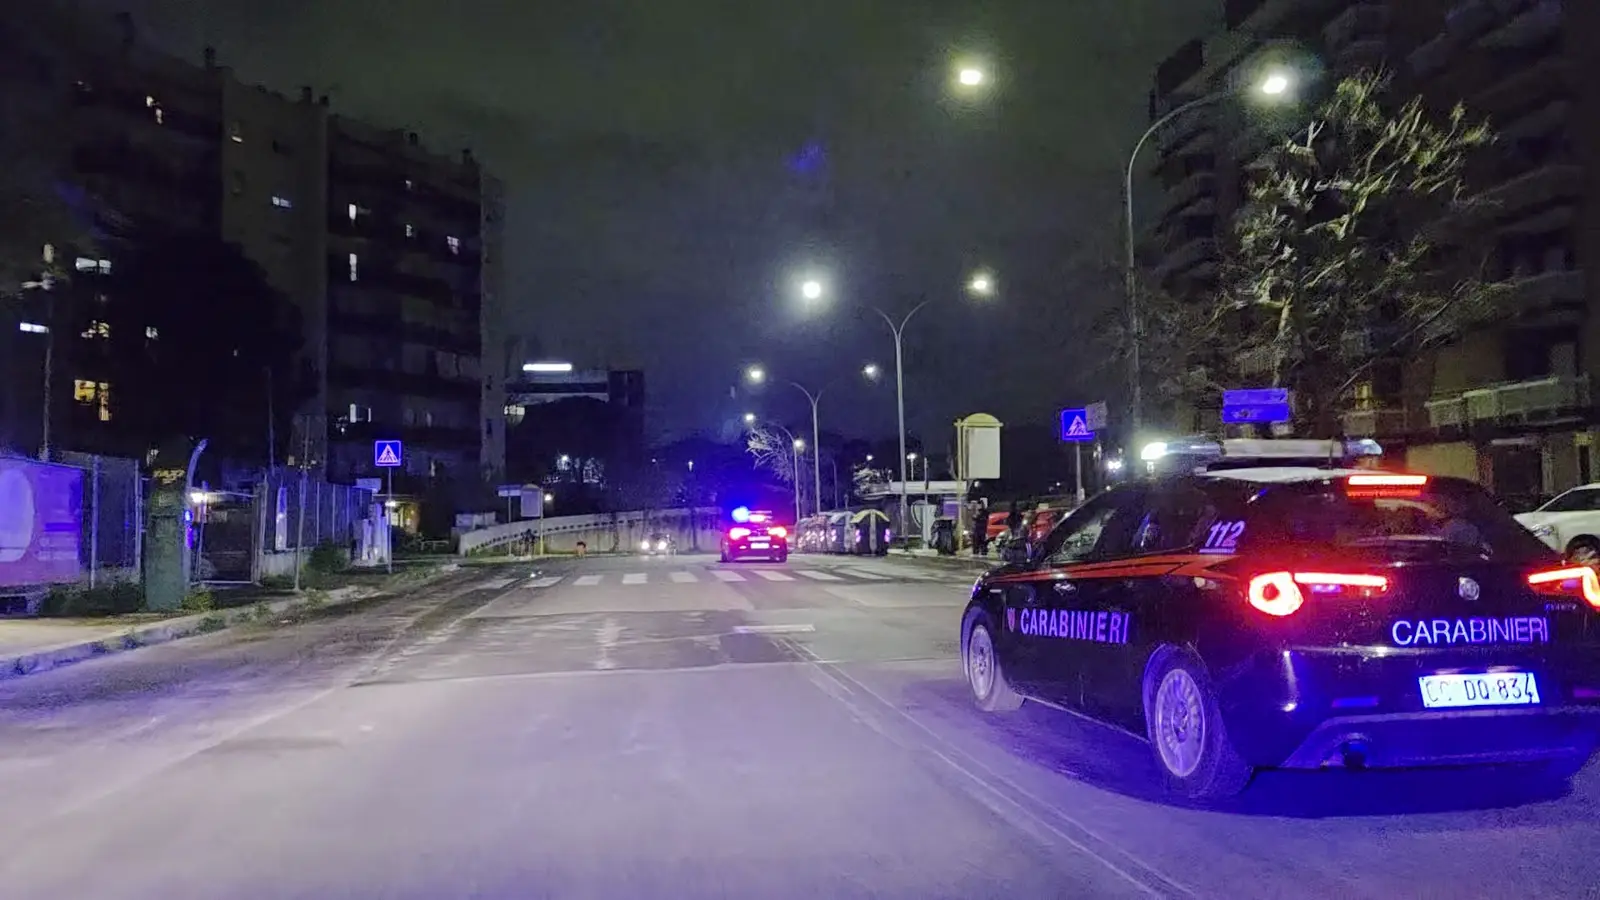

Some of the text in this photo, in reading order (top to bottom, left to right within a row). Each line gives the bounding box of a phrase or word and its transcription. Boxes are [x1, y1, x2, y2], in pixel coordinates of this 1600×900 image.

[1204, 520, 1246, 548] 112
[1020, 608, 1131, 645] CARABINIERI
[1391, 617, 1549, 645] CARABINIERI
